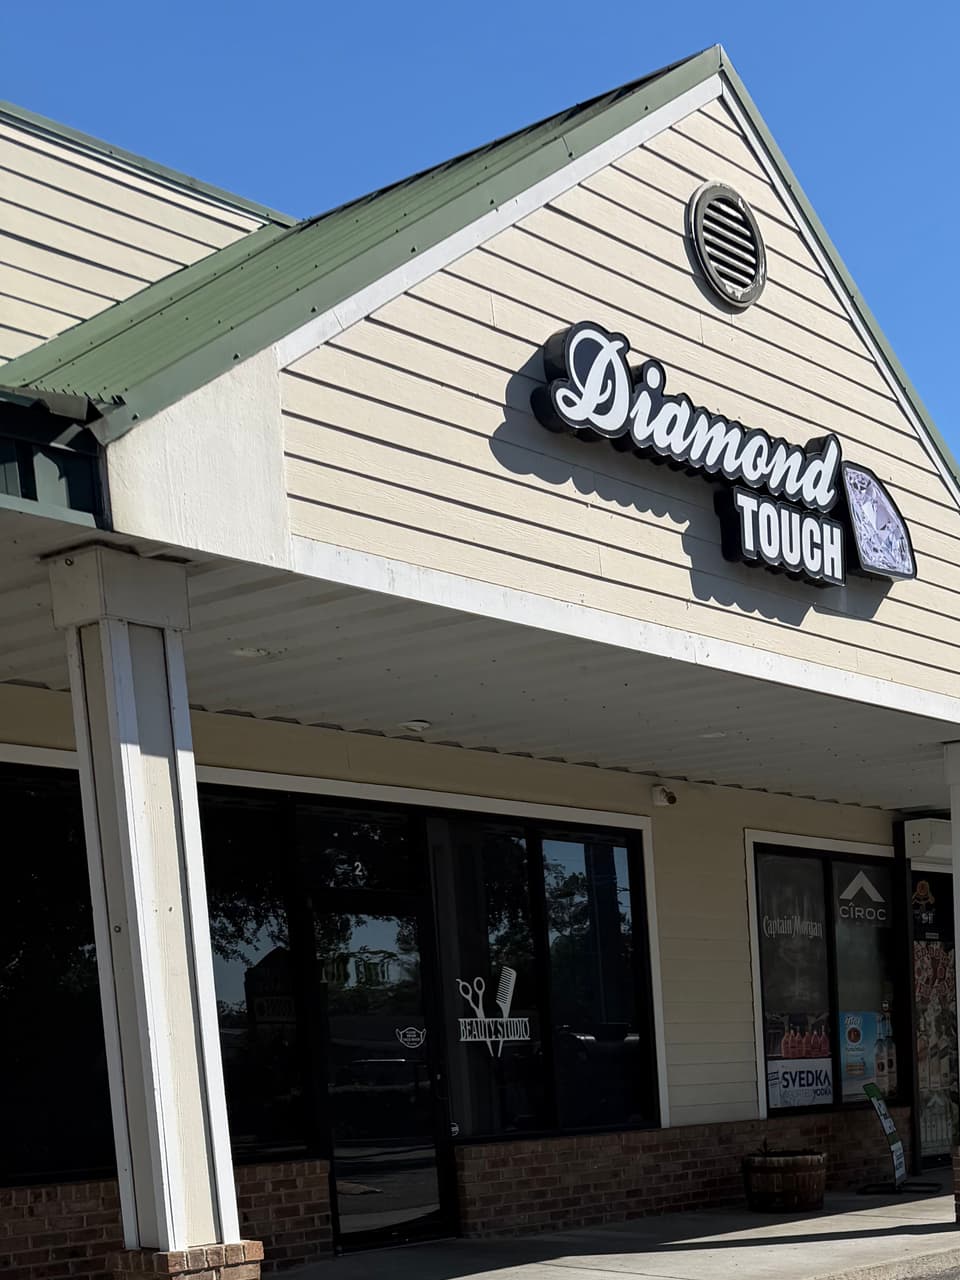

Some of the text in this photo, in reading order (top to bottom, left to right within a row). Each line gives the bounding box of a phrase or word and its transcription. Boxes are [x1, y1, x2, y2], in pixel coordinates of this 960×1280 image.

[555, 328, 841, 503] Diamond
[737, 493, 843, 580] TOUCH
[354, 861, 363, 875] 2
[763, 915, 793, 938] Captain
[460, 1018, 531, 1041] BEAUTY STUDIO
[782, 1070, 832, 1089] SVEDKA
